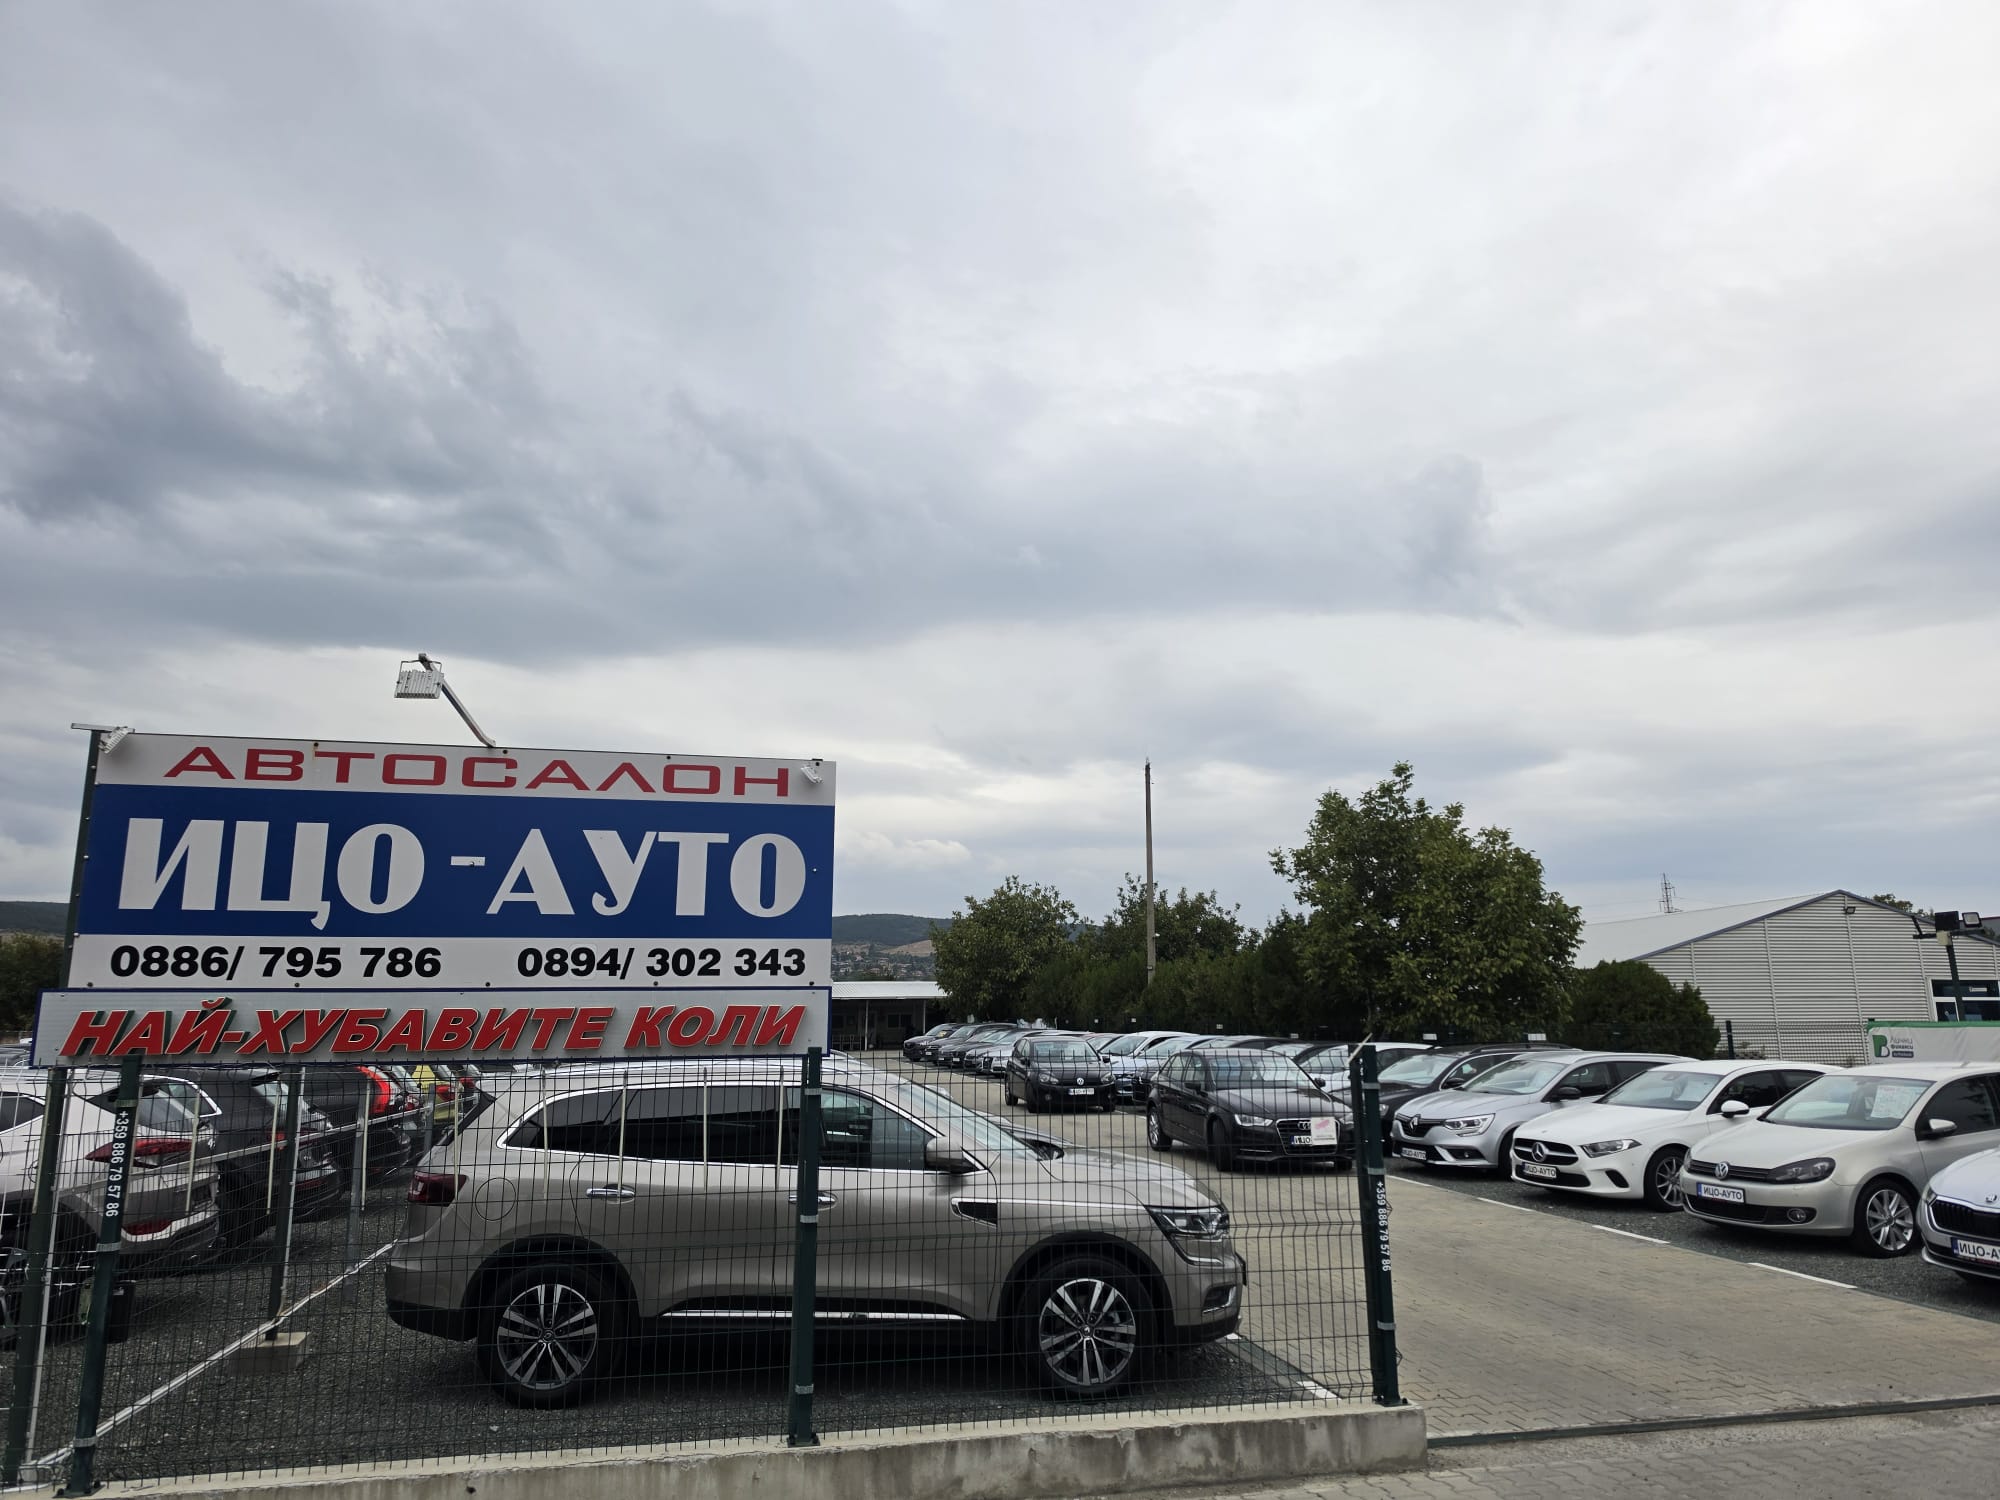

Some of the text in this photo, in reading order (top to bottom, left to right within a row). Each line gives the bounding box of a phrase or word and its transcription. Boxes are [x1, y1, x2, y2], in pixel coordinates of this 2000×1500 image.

[165, 746, 789, 798] АВТОСАЛОН
[110, 945, 442, 981] 0886/ 795 786
[517, 947, 806, 980] 0894/ 302 343
[60, 997, 806, 1056] НАЙ-ХУБАВИТЕ КОЛИ
[105, 1110, 129, 1217] +359 886 79 57 86
[1703, 1186, 1743, 1200] ИЦО-АУТО
[1376, 1181, 1391, 1272] +359 886 79 57 86
[1960, 1241, 2000, 1259] ИЦО-А
